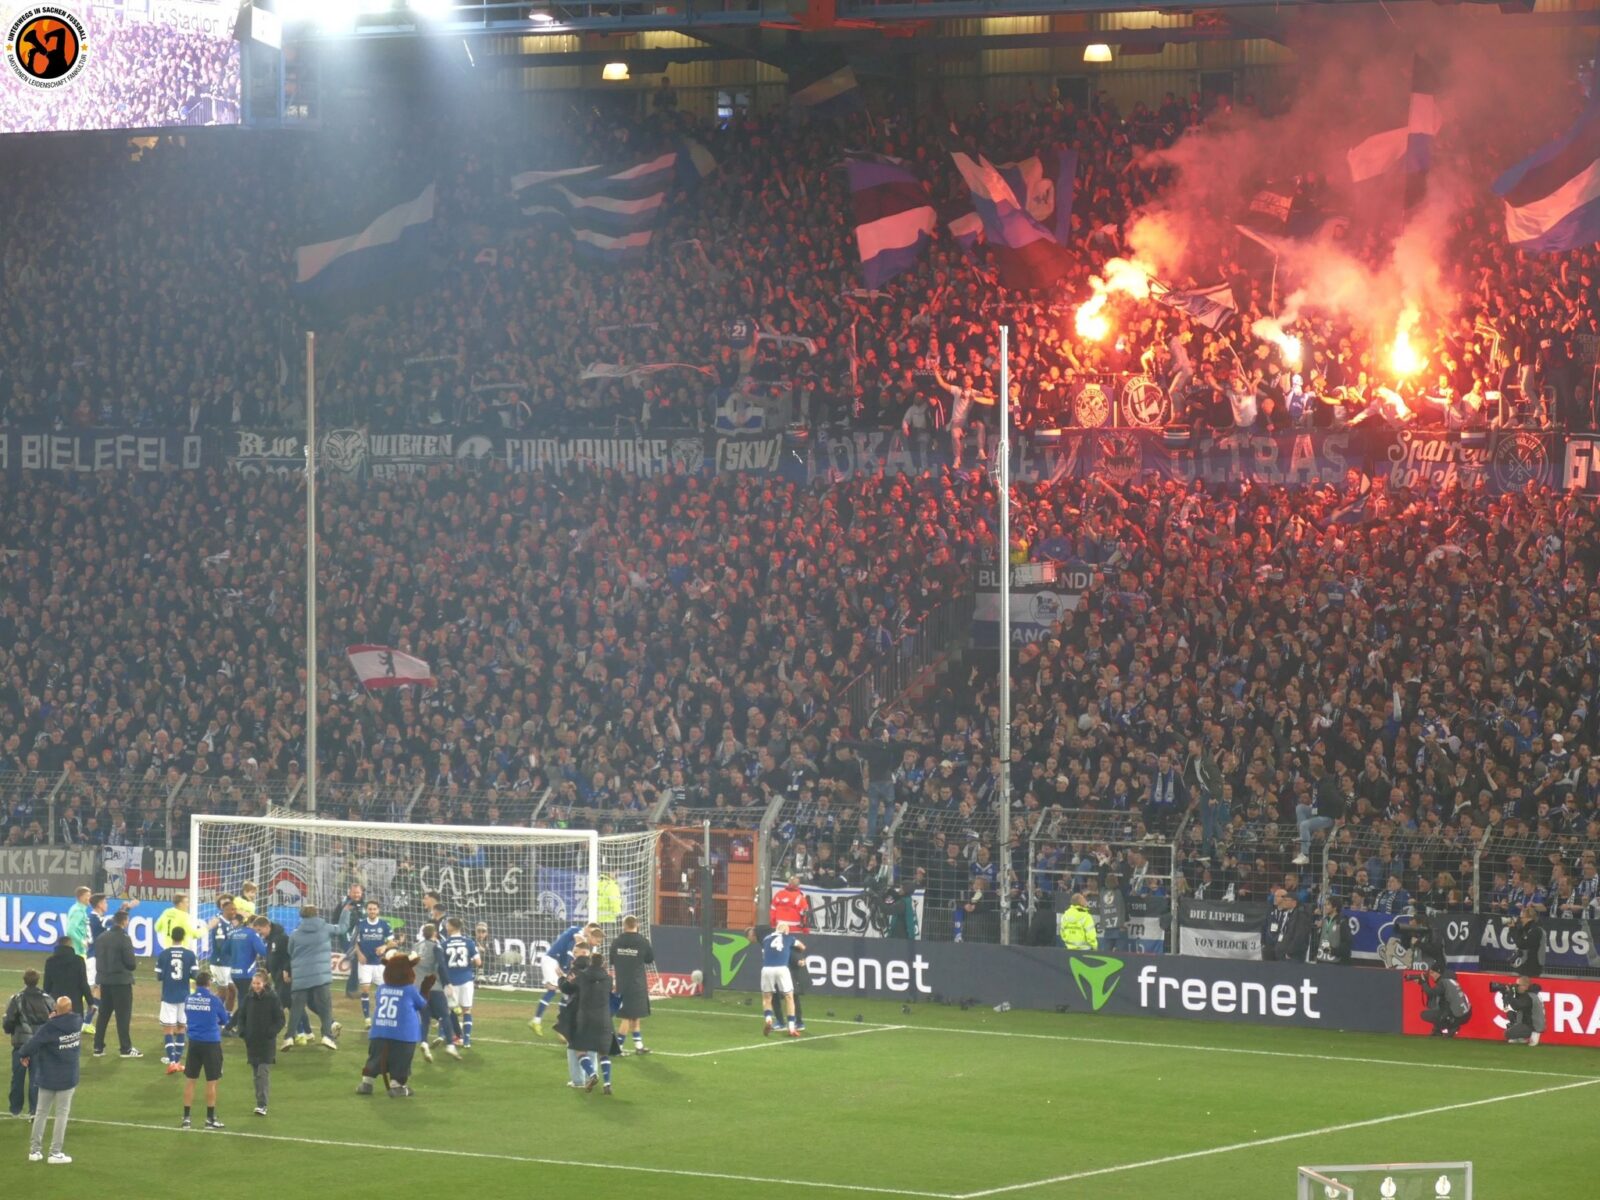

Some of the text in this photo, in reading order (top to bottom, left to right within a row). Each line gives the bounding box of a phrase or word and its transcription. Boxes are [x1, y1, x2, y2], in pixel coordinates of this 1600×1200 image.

[21, 433, 202, 472] BIELEFELD
[154, 849, 188, 880] BAD
[17, 879, 49, 894] TOUR
[1189, 909, 1245, 923] DIE LIPPER
[1447, 921, 1470, 941] 05
[770, 933, 784, 952] 4
[1194, 938, 1257, 951] VON BLOCK 3
[446, 946, 468, 968] 23
[170, 958, 183, 980] 3
[1138, 965, 1321, 1019] freenet
[378, 995, 399, 1019] 26
